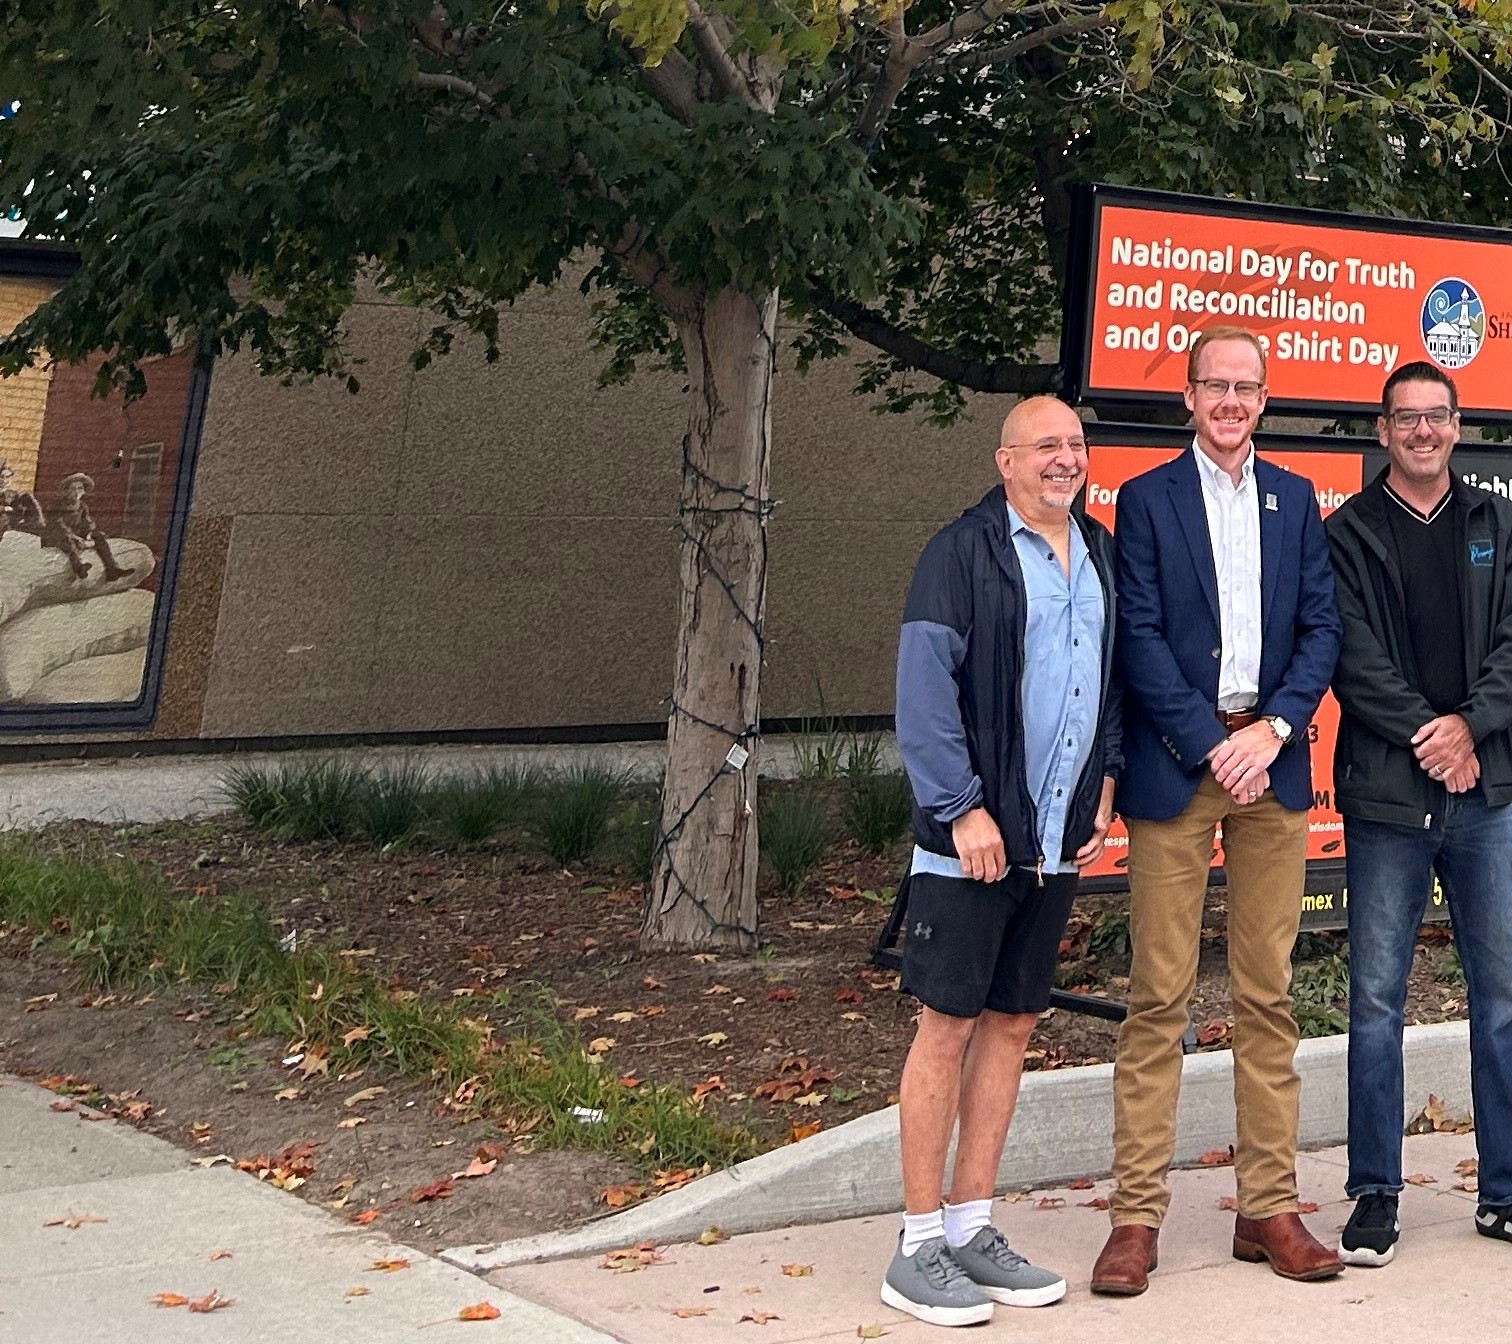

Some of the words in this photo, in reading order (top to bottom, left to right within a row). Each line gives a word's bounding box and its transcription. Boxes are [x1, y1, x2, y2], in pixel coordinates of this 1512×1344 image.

[1111, 236, 1234, 275] National
[1240, 248, 1293, 285] Day
[1298, 252, 1340, 283] for
[1345, 257, 1416, 290] Truth
[1107, 279, 1163, 311] and
[1170, 282, 1366, 325] Reconciliation
[1104, 321, 1162, 351] and
[1277, 330, 1343, 363] Shirt
[1349, 336, 1400, 373] Day
[1301, 893, 1334, 911] mex
